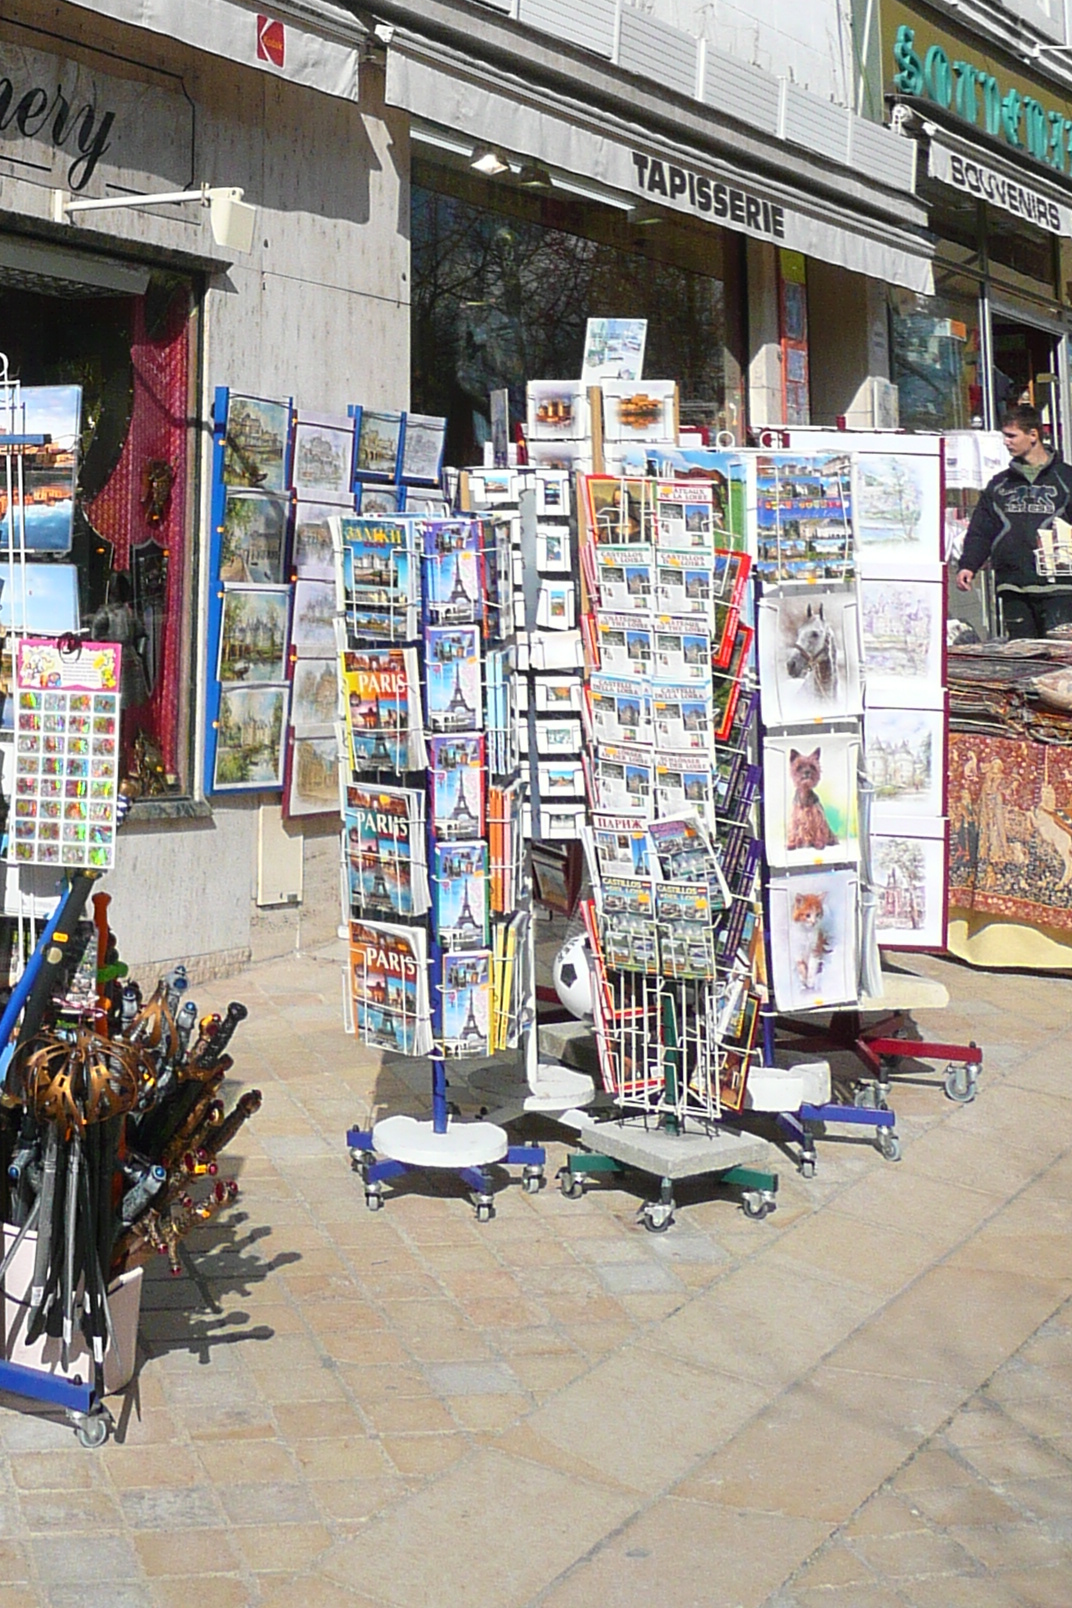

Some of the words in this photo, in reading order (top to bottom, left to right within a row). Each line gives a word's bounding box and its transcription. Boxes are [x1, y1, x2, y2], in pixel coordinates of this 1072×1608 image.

[632, 152, 785, 239] TAPISSERIE
[950, 155, 1061, 231] SOUVENIRS
[359, 672, 406, 693] PARIS
[357, 812, 408, 837] PARIS
[597, 817, 644, 830] ПАРИЖ
[602, 877, 642, 889] CASTILLOS
[657, 884, 698, 894] CASTILLOS
[366, 947, 416, 975] PARIS
